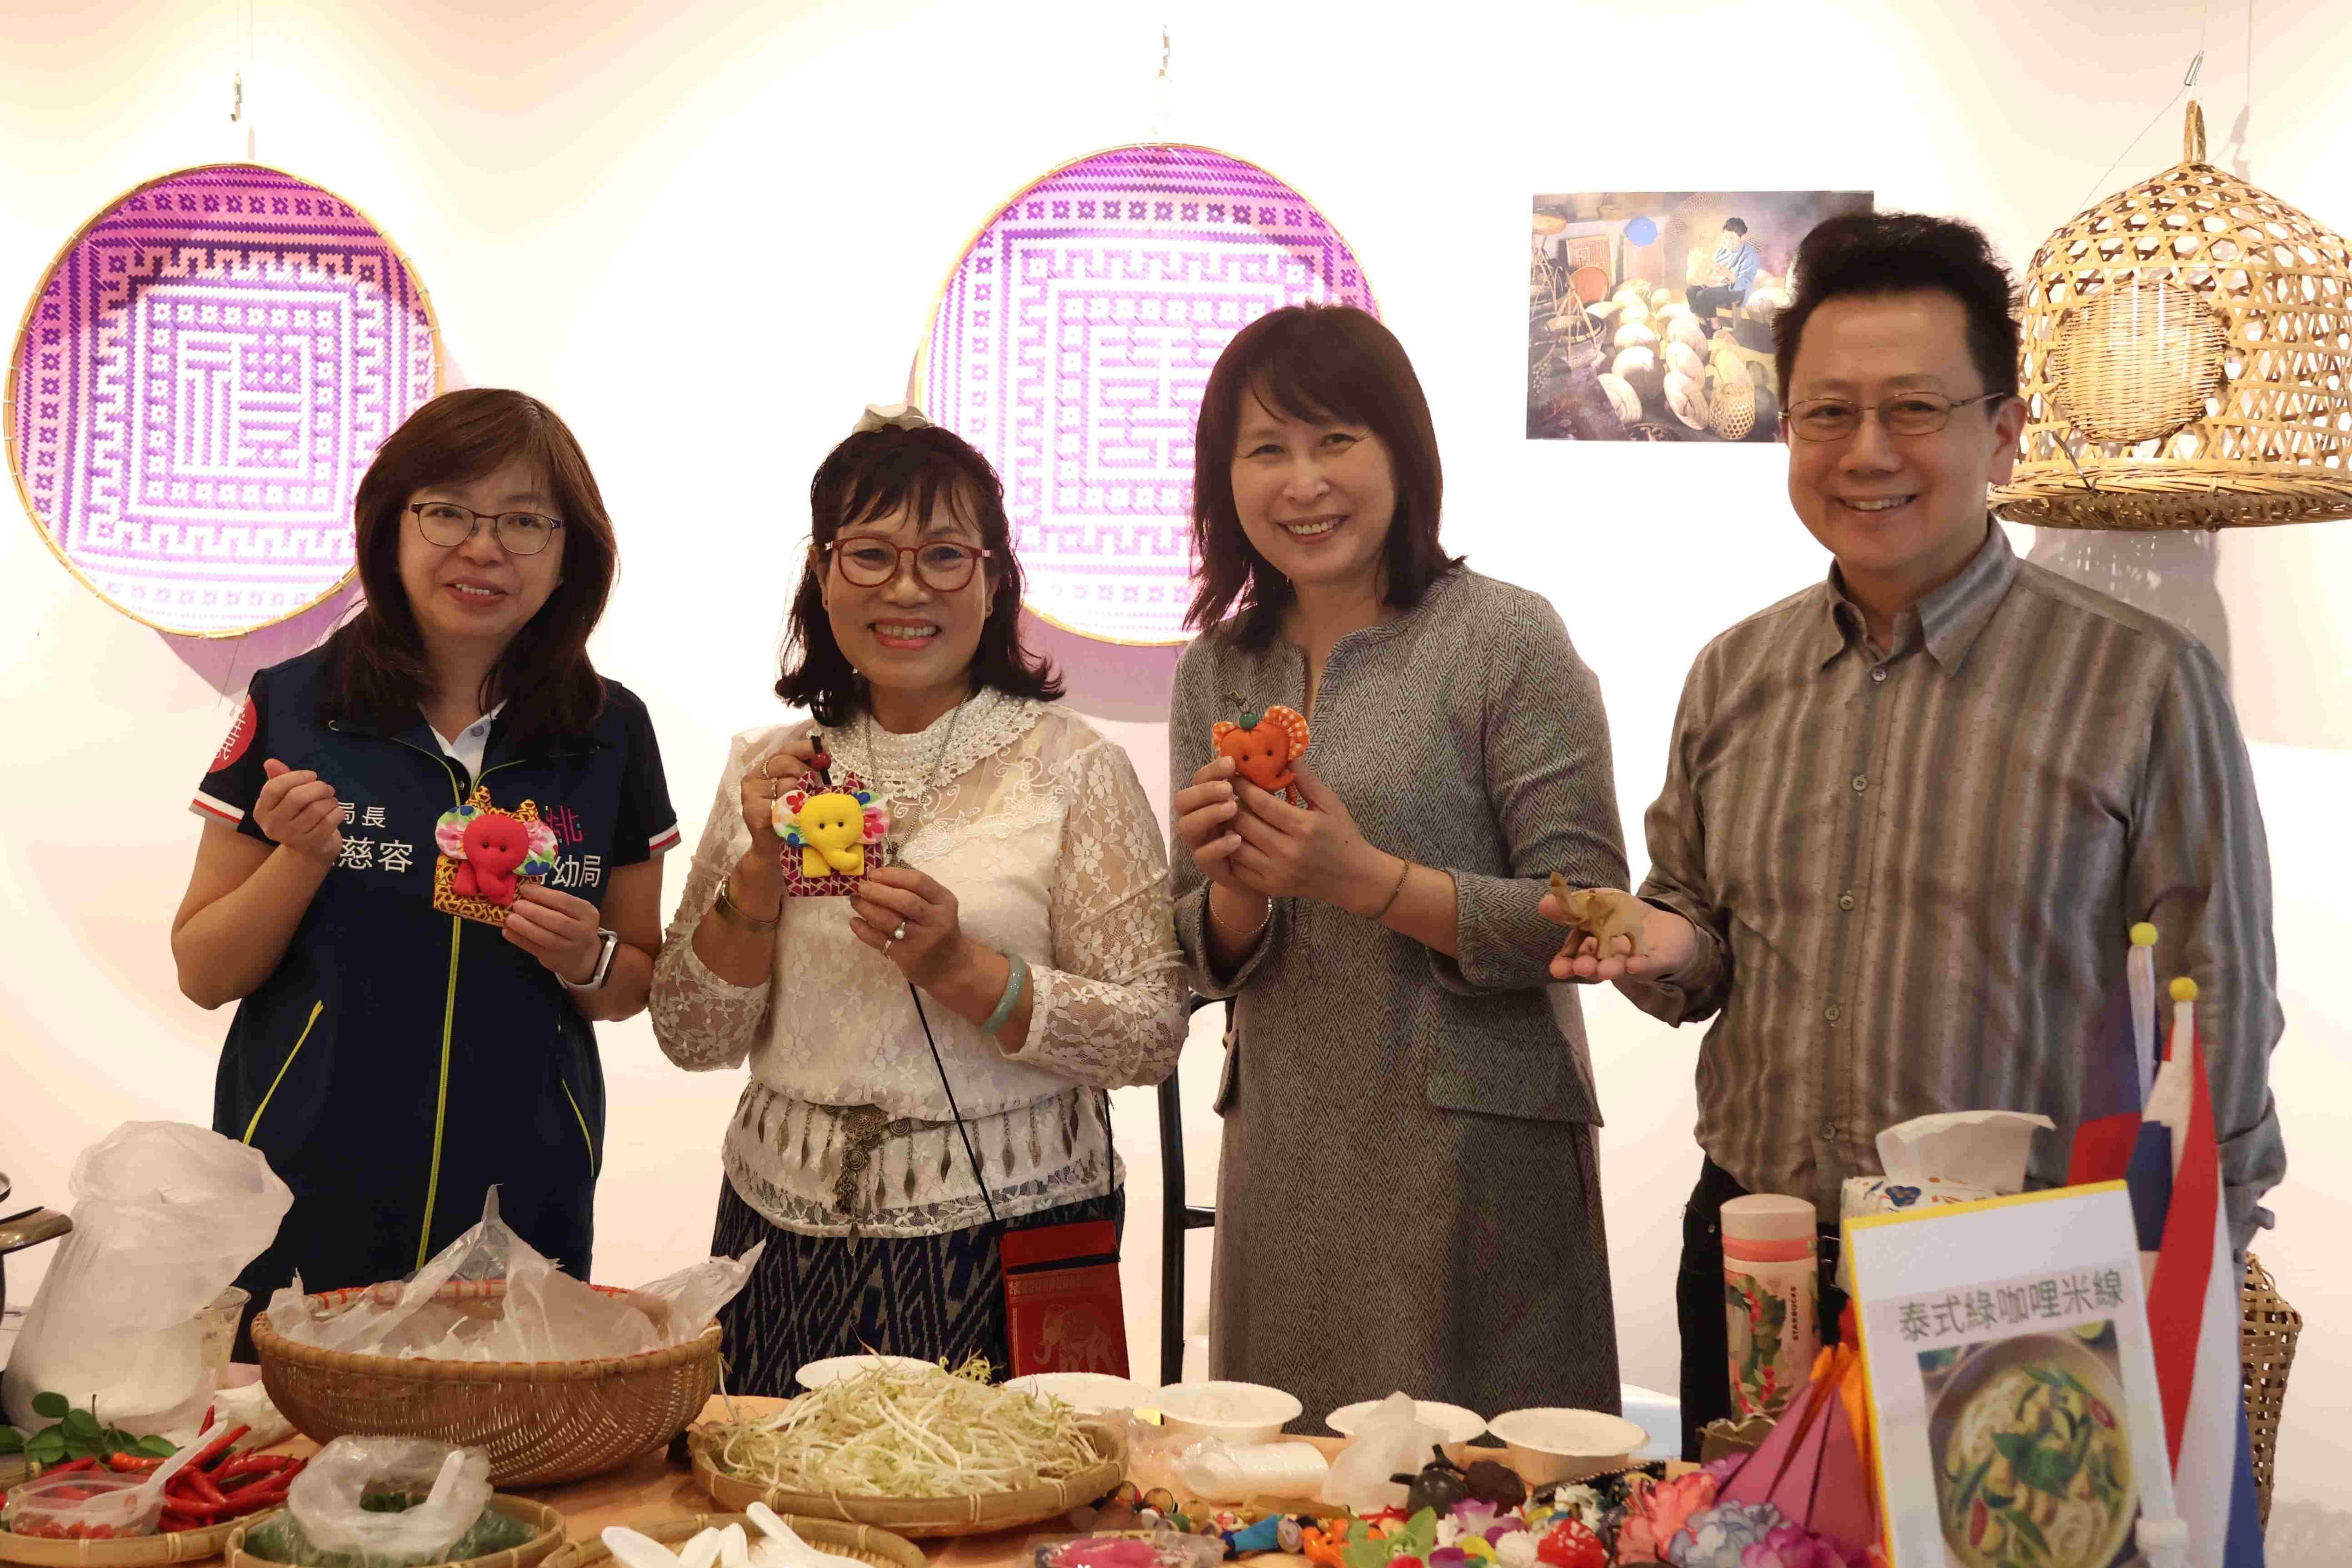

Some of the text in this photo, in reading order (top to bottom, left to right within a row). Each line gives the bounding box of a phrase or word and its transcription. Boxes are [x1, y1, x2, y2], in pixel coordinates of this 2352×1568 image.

[332, 835, 413, 873] 慈容
[540, 855, 601, 888] 幼局
[1790, 1286, 1799, 1341] STARBUCKS
[1898, 1269, 2124, 1342] 泰式綠咖哩米線
